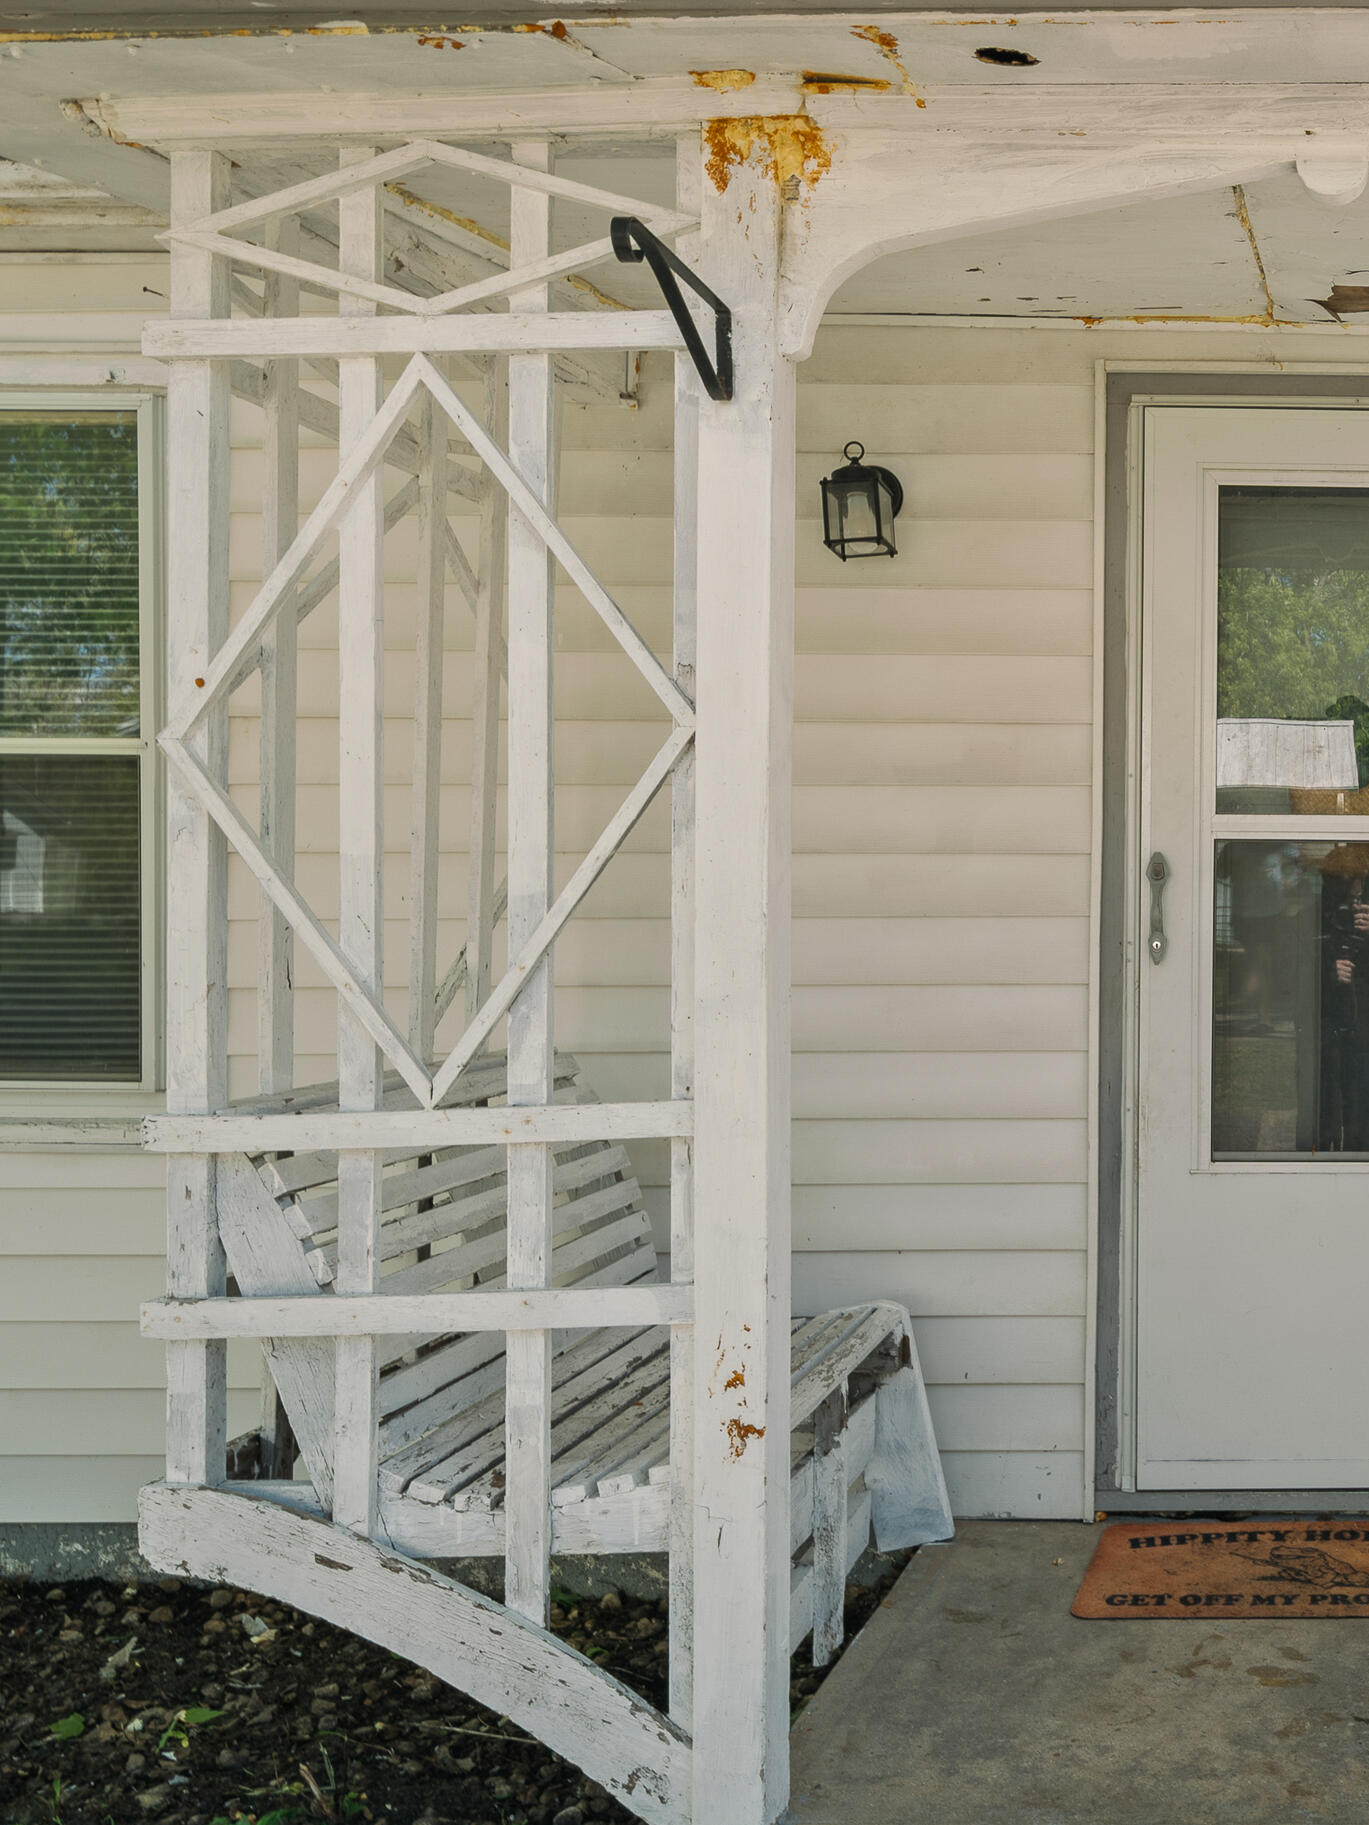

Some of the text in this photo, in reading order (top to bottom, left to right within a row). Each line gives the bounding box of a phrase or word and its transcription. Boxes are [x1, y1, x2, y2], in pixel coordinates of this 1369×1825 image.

[1128, 1529, 1294, 1549] HIPPITY
[1104, 1593, 1172, 1607] GET
[1178, 1593, 1247, 1607] OFF
[1250, 1593, 1299, 1607] MY
